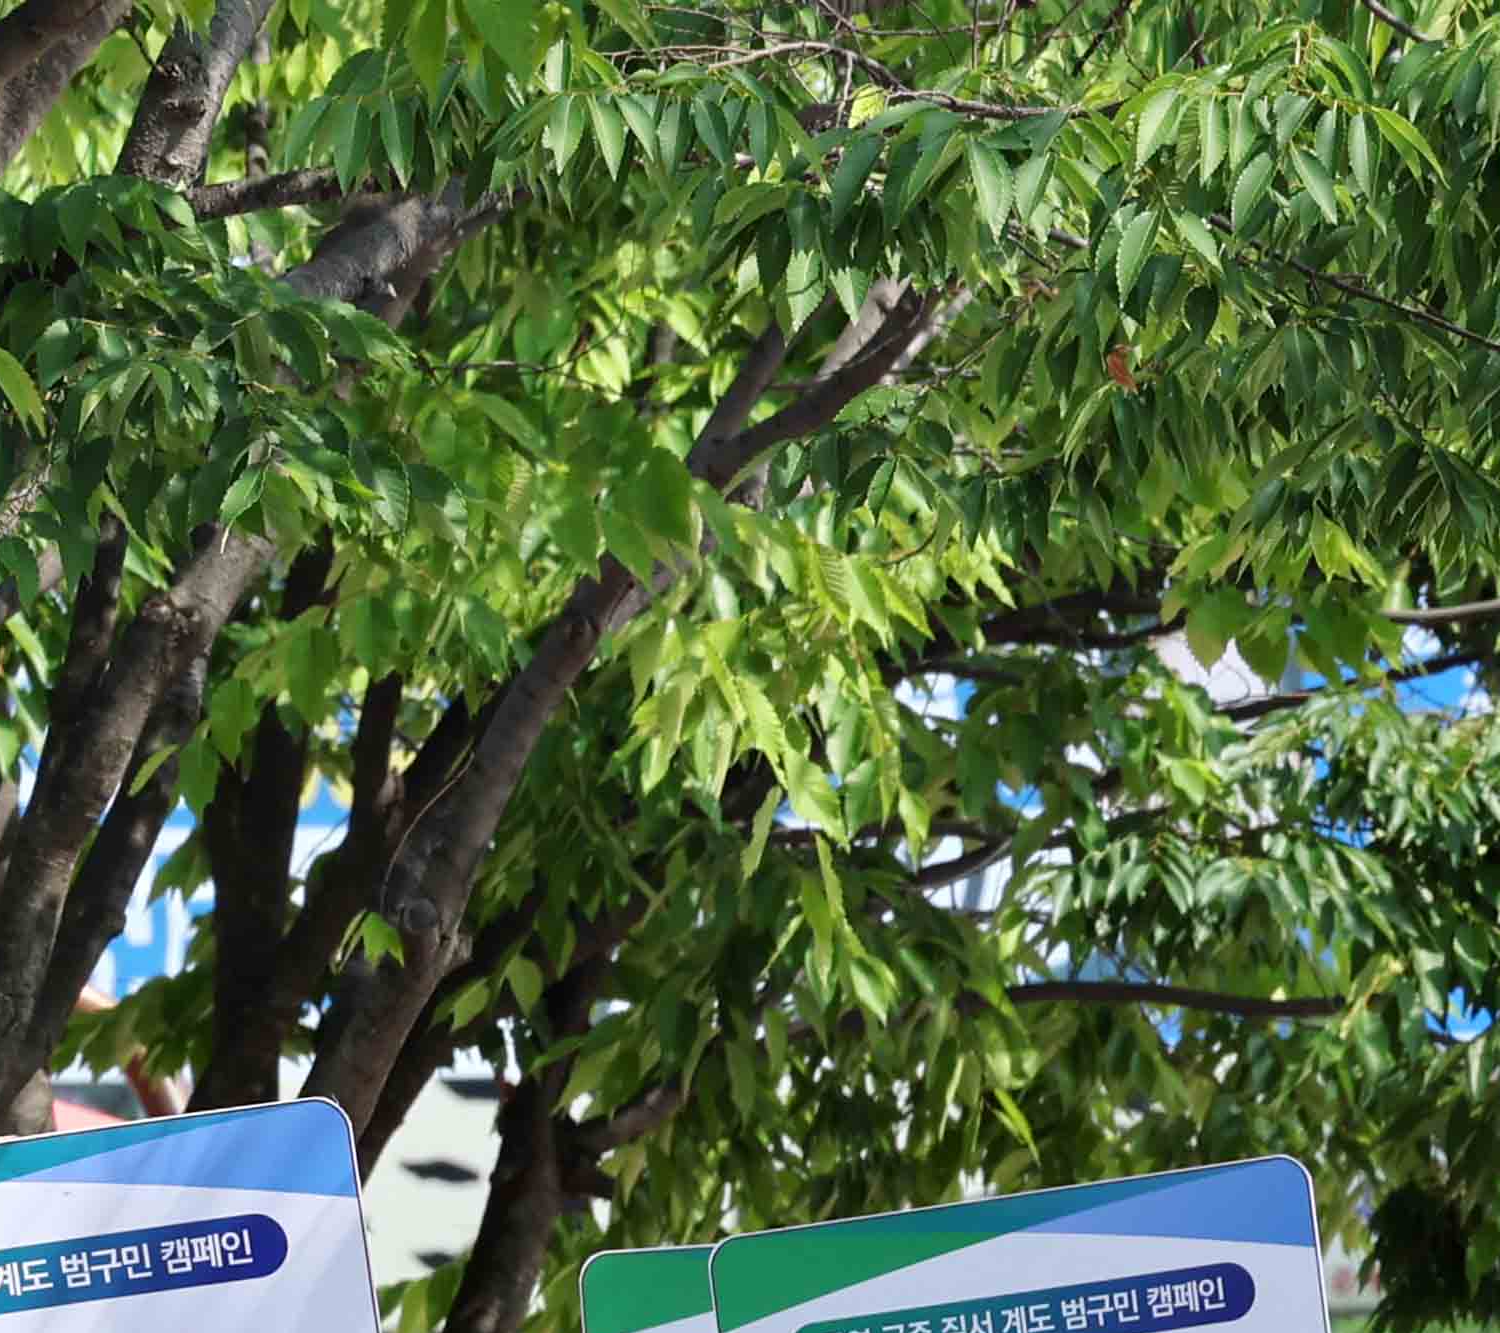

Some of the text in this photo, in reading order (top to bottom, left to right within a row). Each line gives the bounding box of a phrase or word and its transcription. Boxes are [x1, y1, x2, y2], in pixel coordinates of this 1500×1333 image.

[60, 1241, 152, 1286] 범구민
[161, 1228, 254, 1273] 캠페인
[1061, 1289, 1140, 1331] 범구민
[1148, 1278, 1226, 1321] 캠페인
